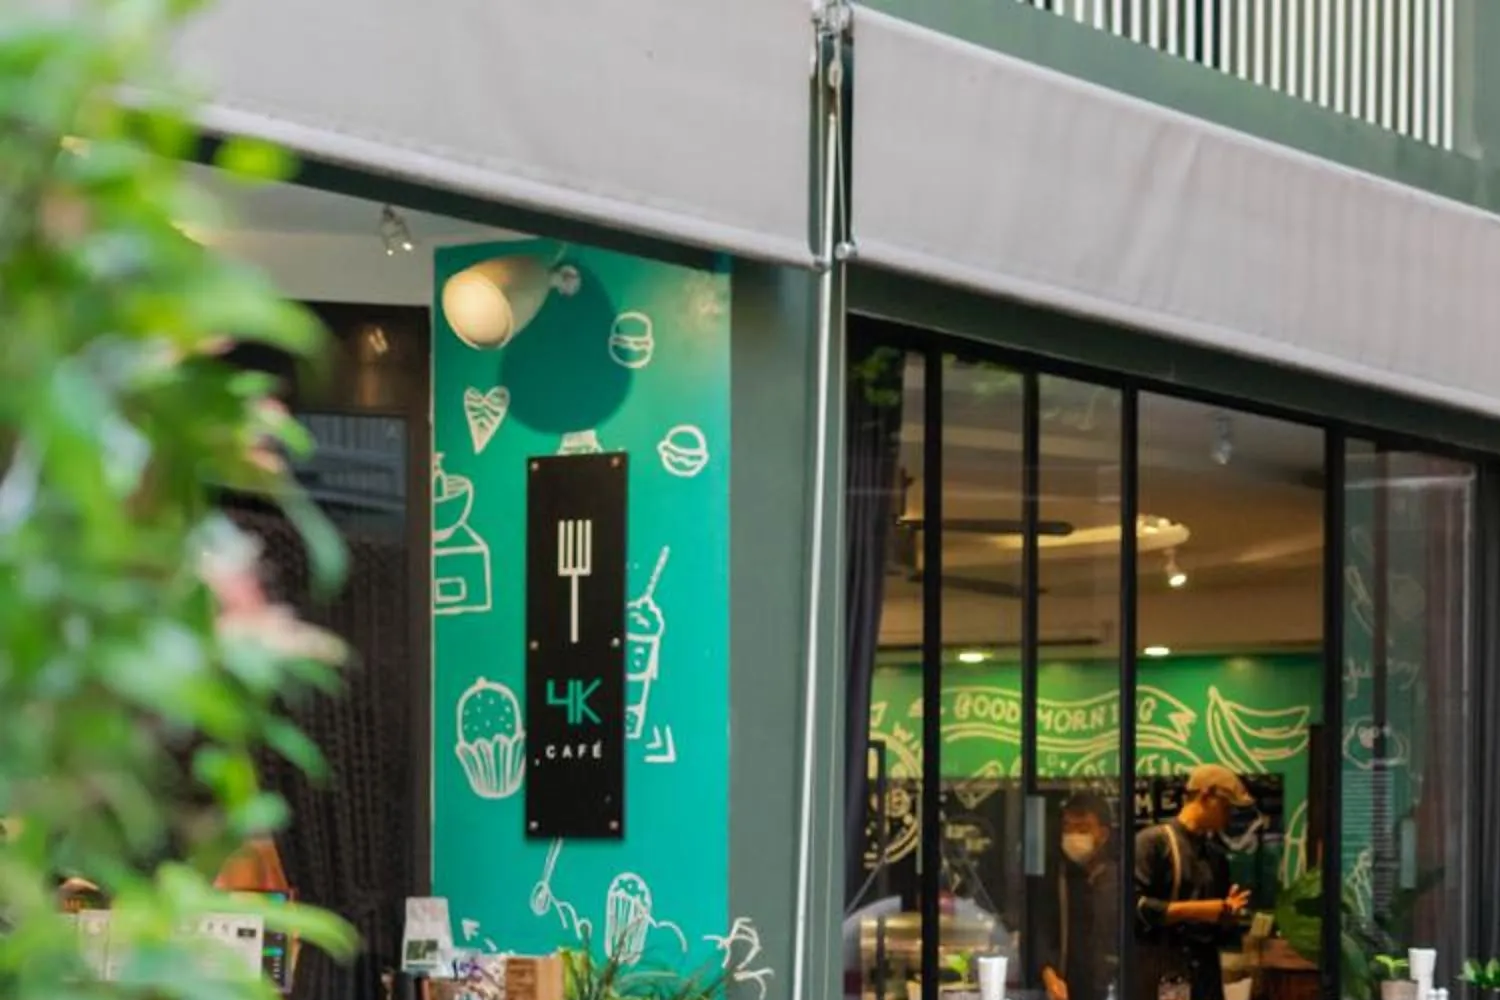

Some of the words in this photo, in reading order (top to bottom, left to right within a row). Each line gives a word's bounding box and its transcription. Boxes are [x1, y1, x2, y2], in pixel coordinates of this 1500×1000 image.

[546, 678, 602, 724] 4K
[954, 692, 1021, 724] GOOD
[1036, 696, 1158, 733] MORNIG
[545, 740, 603, 760] CAFÉ
